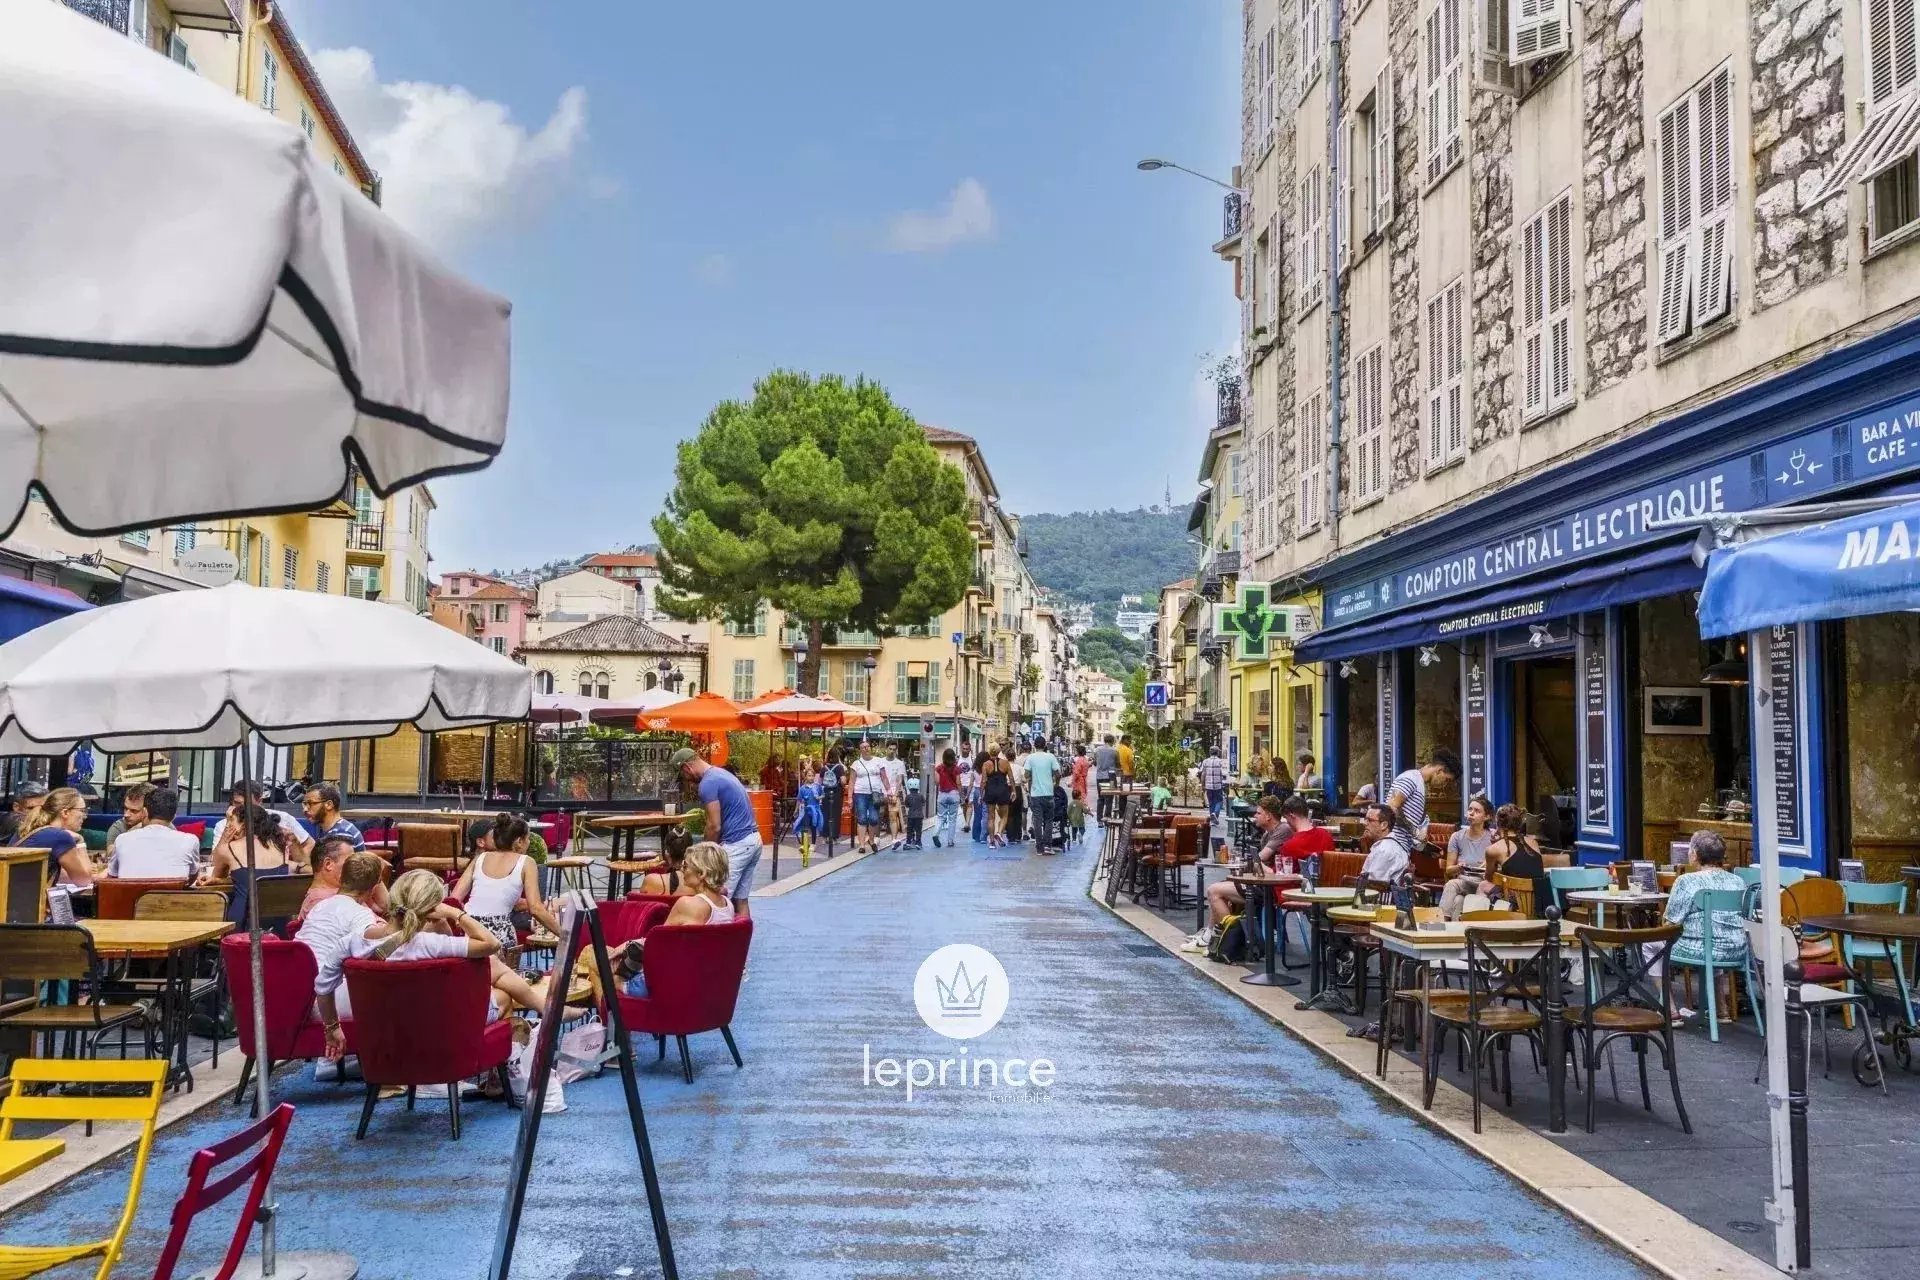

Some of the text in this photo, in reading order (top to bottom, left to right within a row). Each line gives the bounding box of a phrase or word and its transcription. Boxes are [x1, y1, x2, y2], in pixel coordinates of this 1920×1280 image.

[1862, 410, 1920, 444] BAR A VI
[1867, 438, 1906, 464] CAFE
[1405, 475, 1724, 598] COMPTOIR CENTRAL ÉLECTRIQUE
[1837, 520, 1920, 570] MA
[1438, 601, 1544, 634] COMPTOIR CENTRAL ÉLECTRIQUE
[620, 748, 657, 761] POSTO
